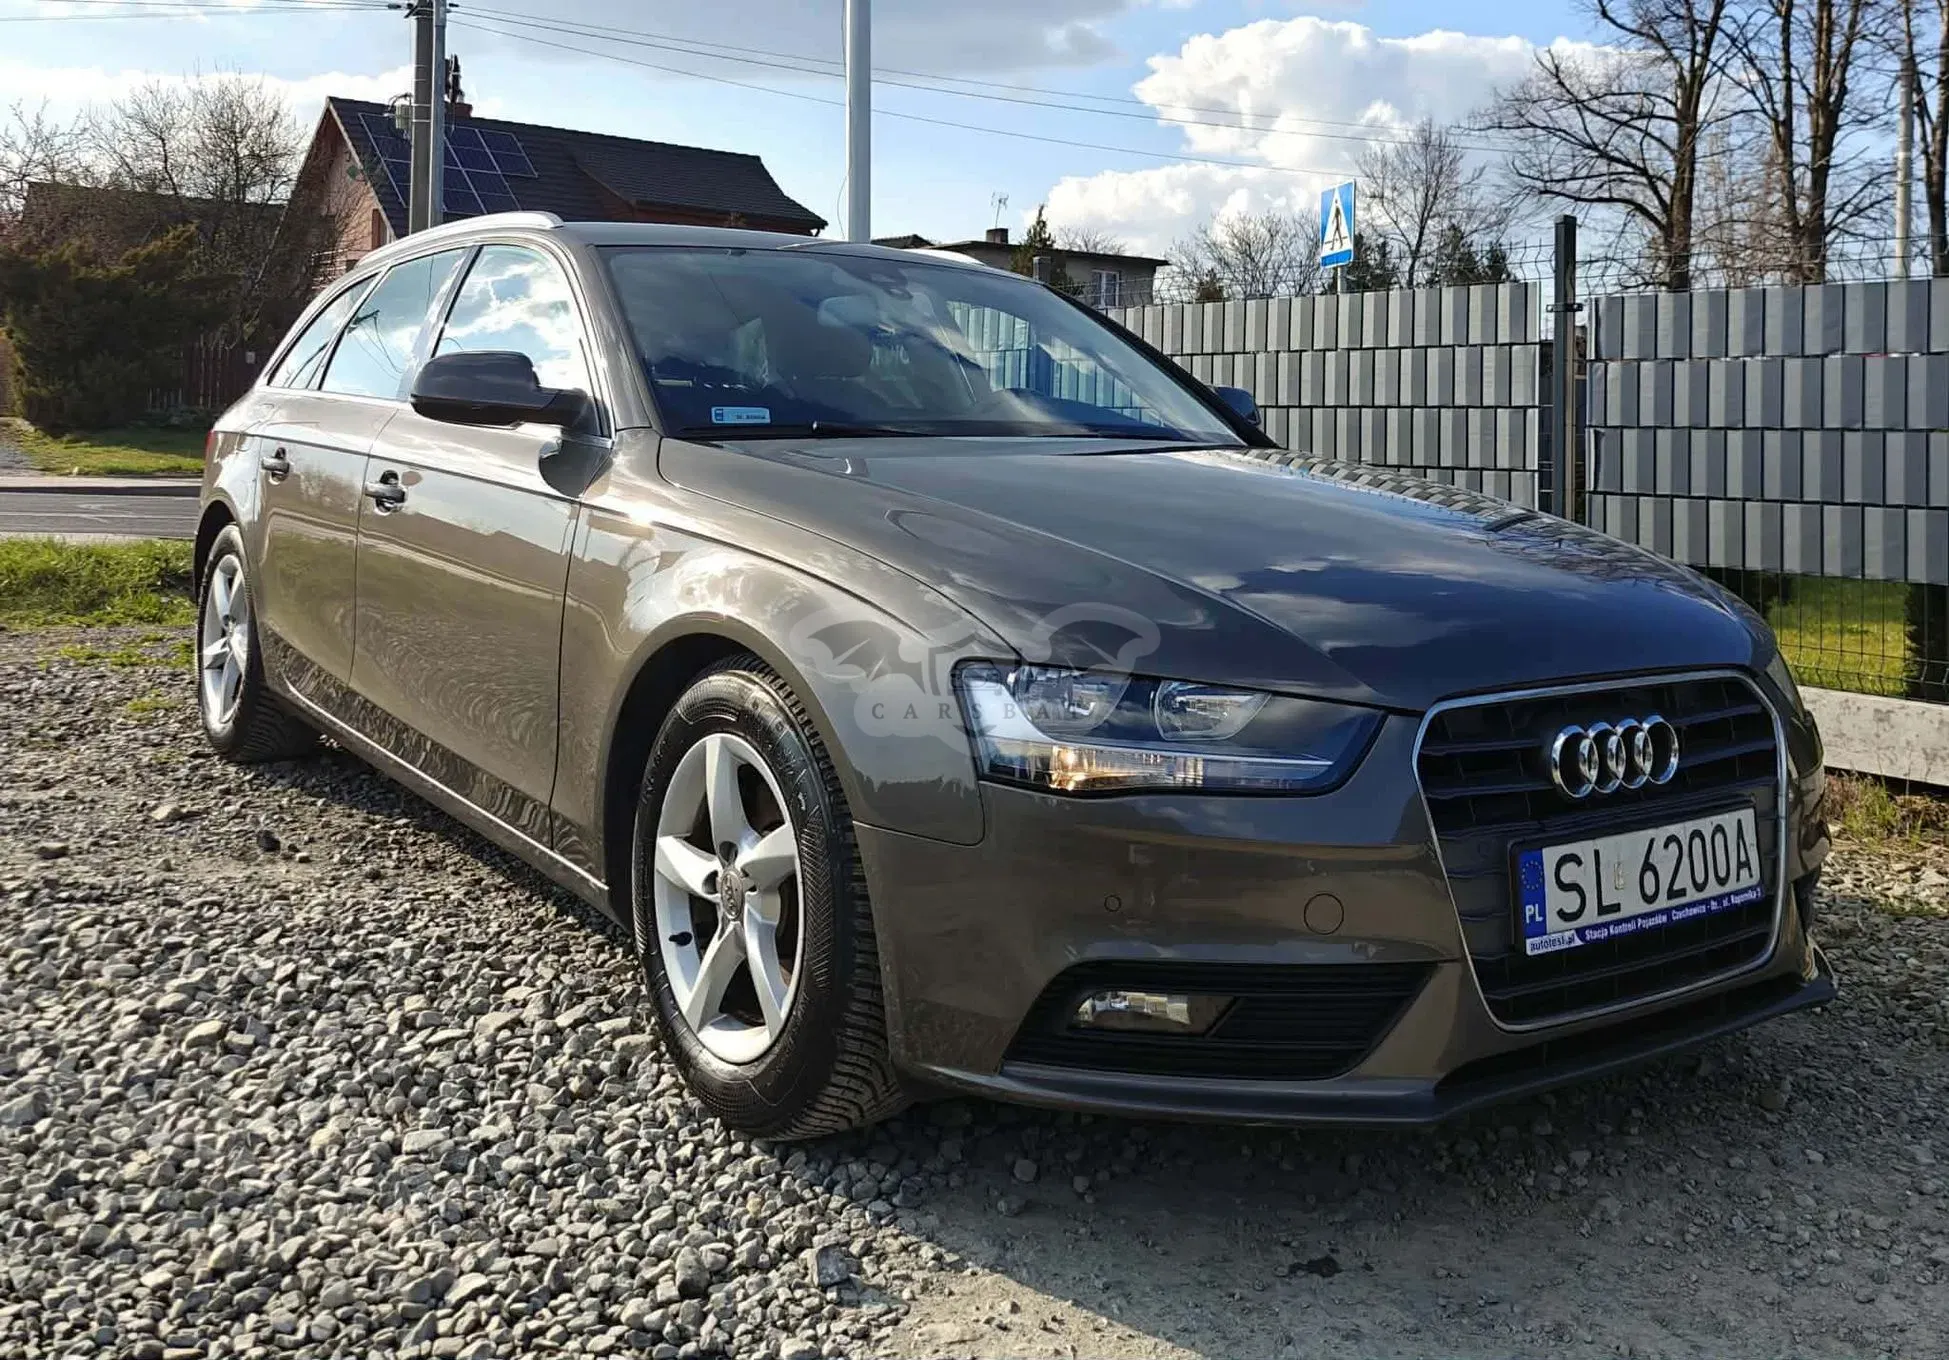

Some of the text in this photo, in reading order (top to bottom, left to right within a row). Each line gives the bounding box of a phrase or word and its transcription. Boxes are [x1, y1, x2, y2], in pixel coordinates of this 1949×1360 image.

[1553, 818, 1754, 923] SL 6200A
[1525, 904, 1544, 924] PL
[1584, 927, 1609, 942] Stacja
[1609, 919, 1637, 936] Kontroli
[1530, 931, 1576, 953] autotest.pl
